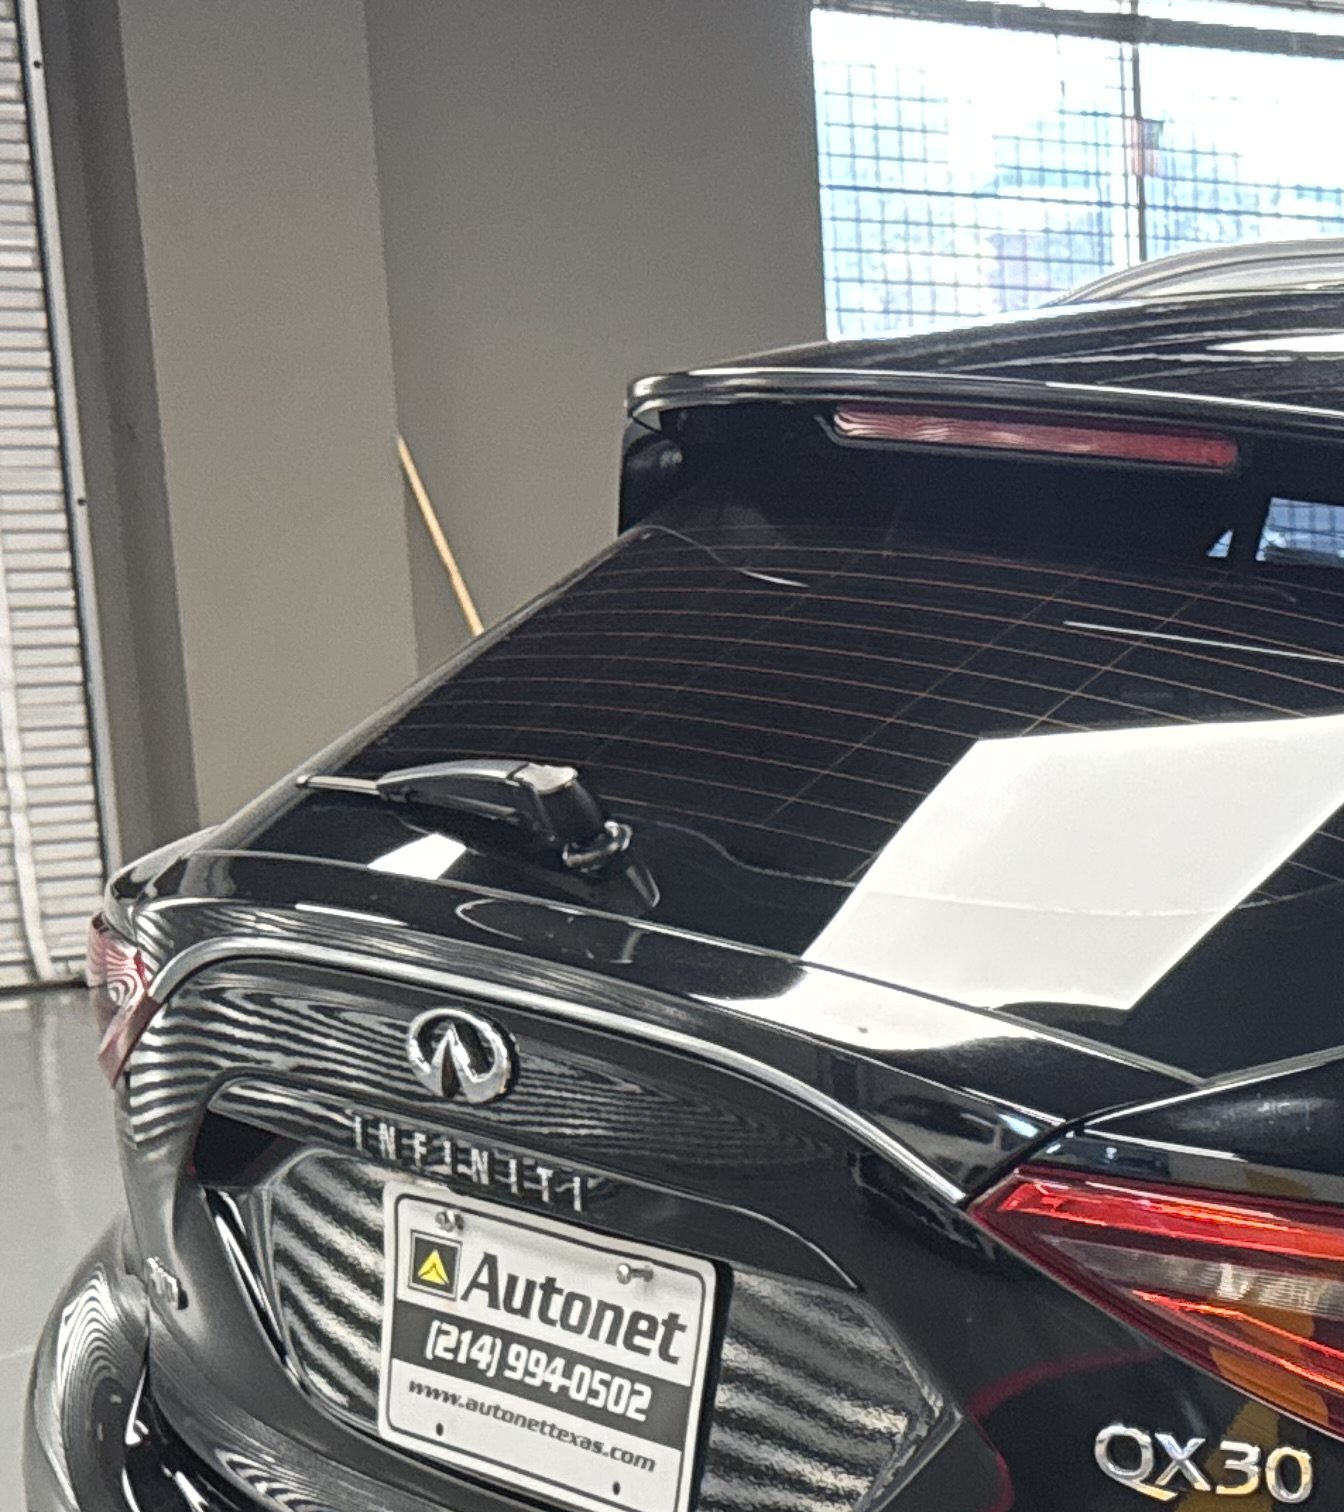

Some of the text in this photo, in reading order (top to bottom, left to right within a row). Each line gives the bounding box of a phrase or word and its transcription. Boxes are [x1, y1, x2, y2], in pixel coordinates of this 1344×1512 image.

[354, 1114, 584, 1213] INFINITI
[460, 1251, 688, 1366] Autonet
[425, 1319, 653, 1423] (214) 994-0502
[408, 1379, 656, 1474] www.autonettexas.com
[1094, 1422, 1314, 1503] QX30
